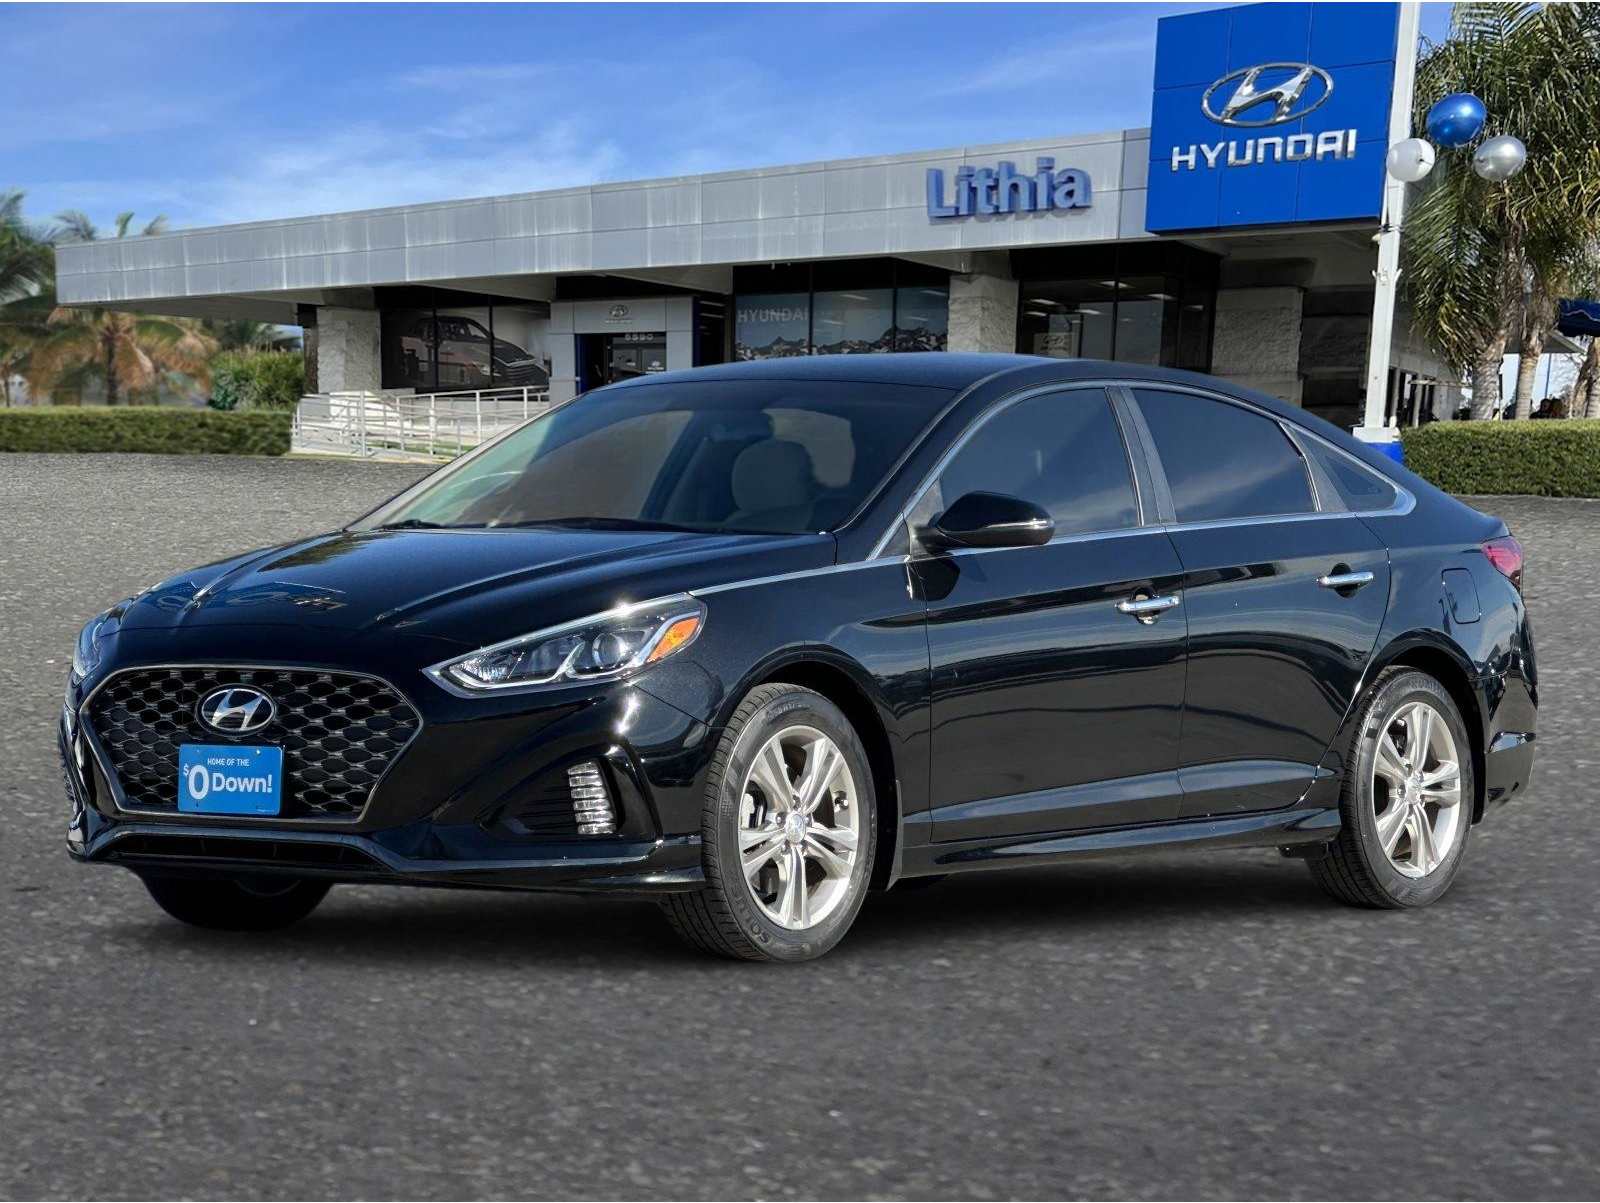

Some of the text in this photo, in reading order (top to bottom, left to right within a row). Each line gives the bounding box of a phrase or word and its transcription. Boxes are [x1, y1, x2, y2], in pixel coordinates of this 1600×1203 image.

[1171, 129, 1357, 172] HYUNDAI
[926, 157, 1092, 219] Lithia
[737, 308, 809, 324] HYUNDAI
[207, 758, 250, 767] HOME OF THE
[212, 773, 273, 794] Down!
